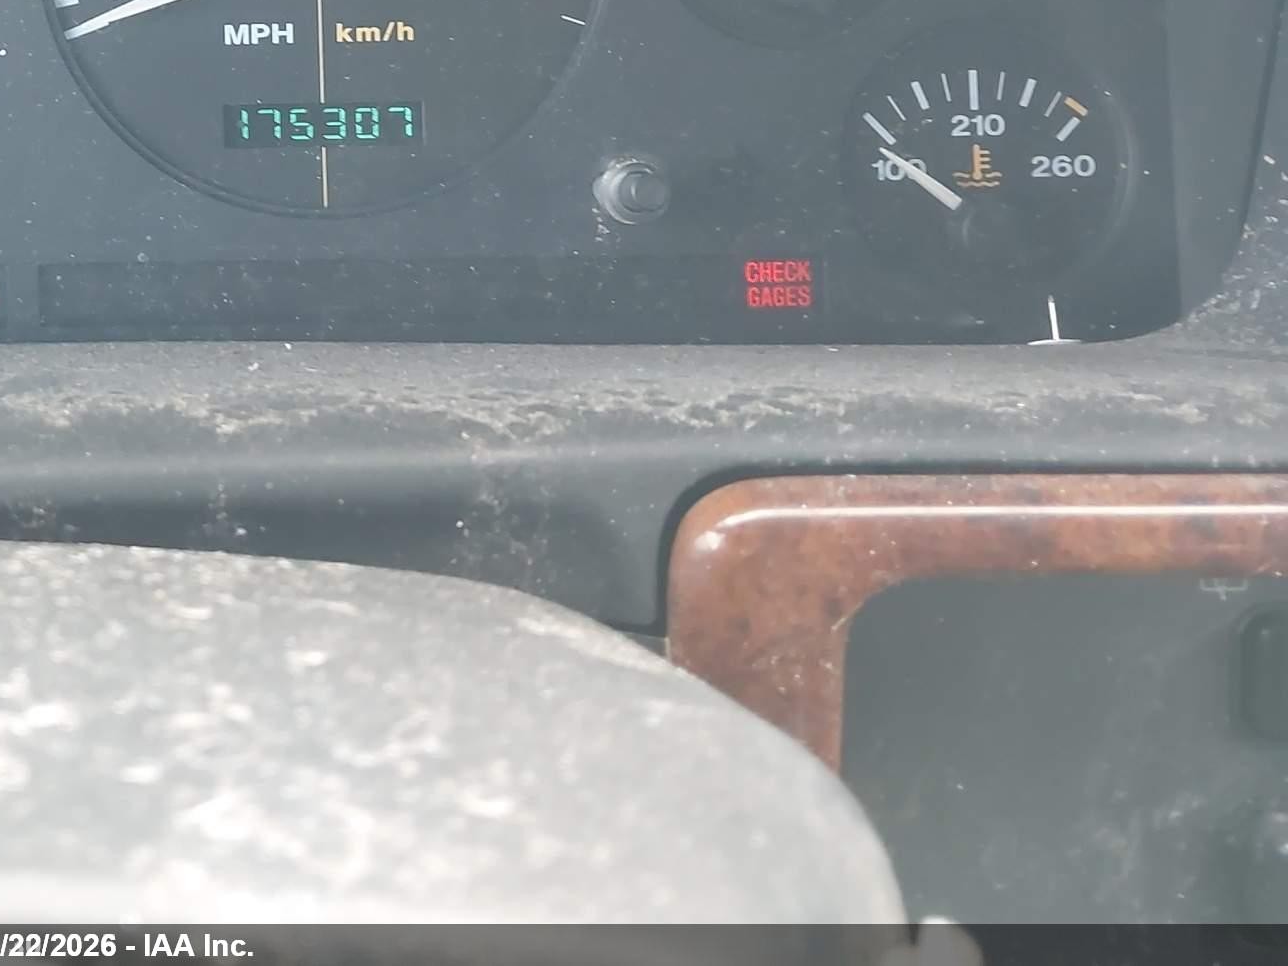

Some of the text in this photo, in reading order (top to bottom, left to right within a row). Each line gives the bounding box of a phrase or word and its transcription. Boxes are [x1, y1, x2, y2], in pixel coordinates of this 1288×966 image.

[223, 22, 295, 46] MPH
[335, 21, 416, 43] km/h
[240, 106, 414, 141] 175307
[950, 113, 1007, 137] 210
[1030, 154, 1097, 178] 260
[744, 259, 811, 283] CHECK
[746, 284, 812, 308] GAGES
